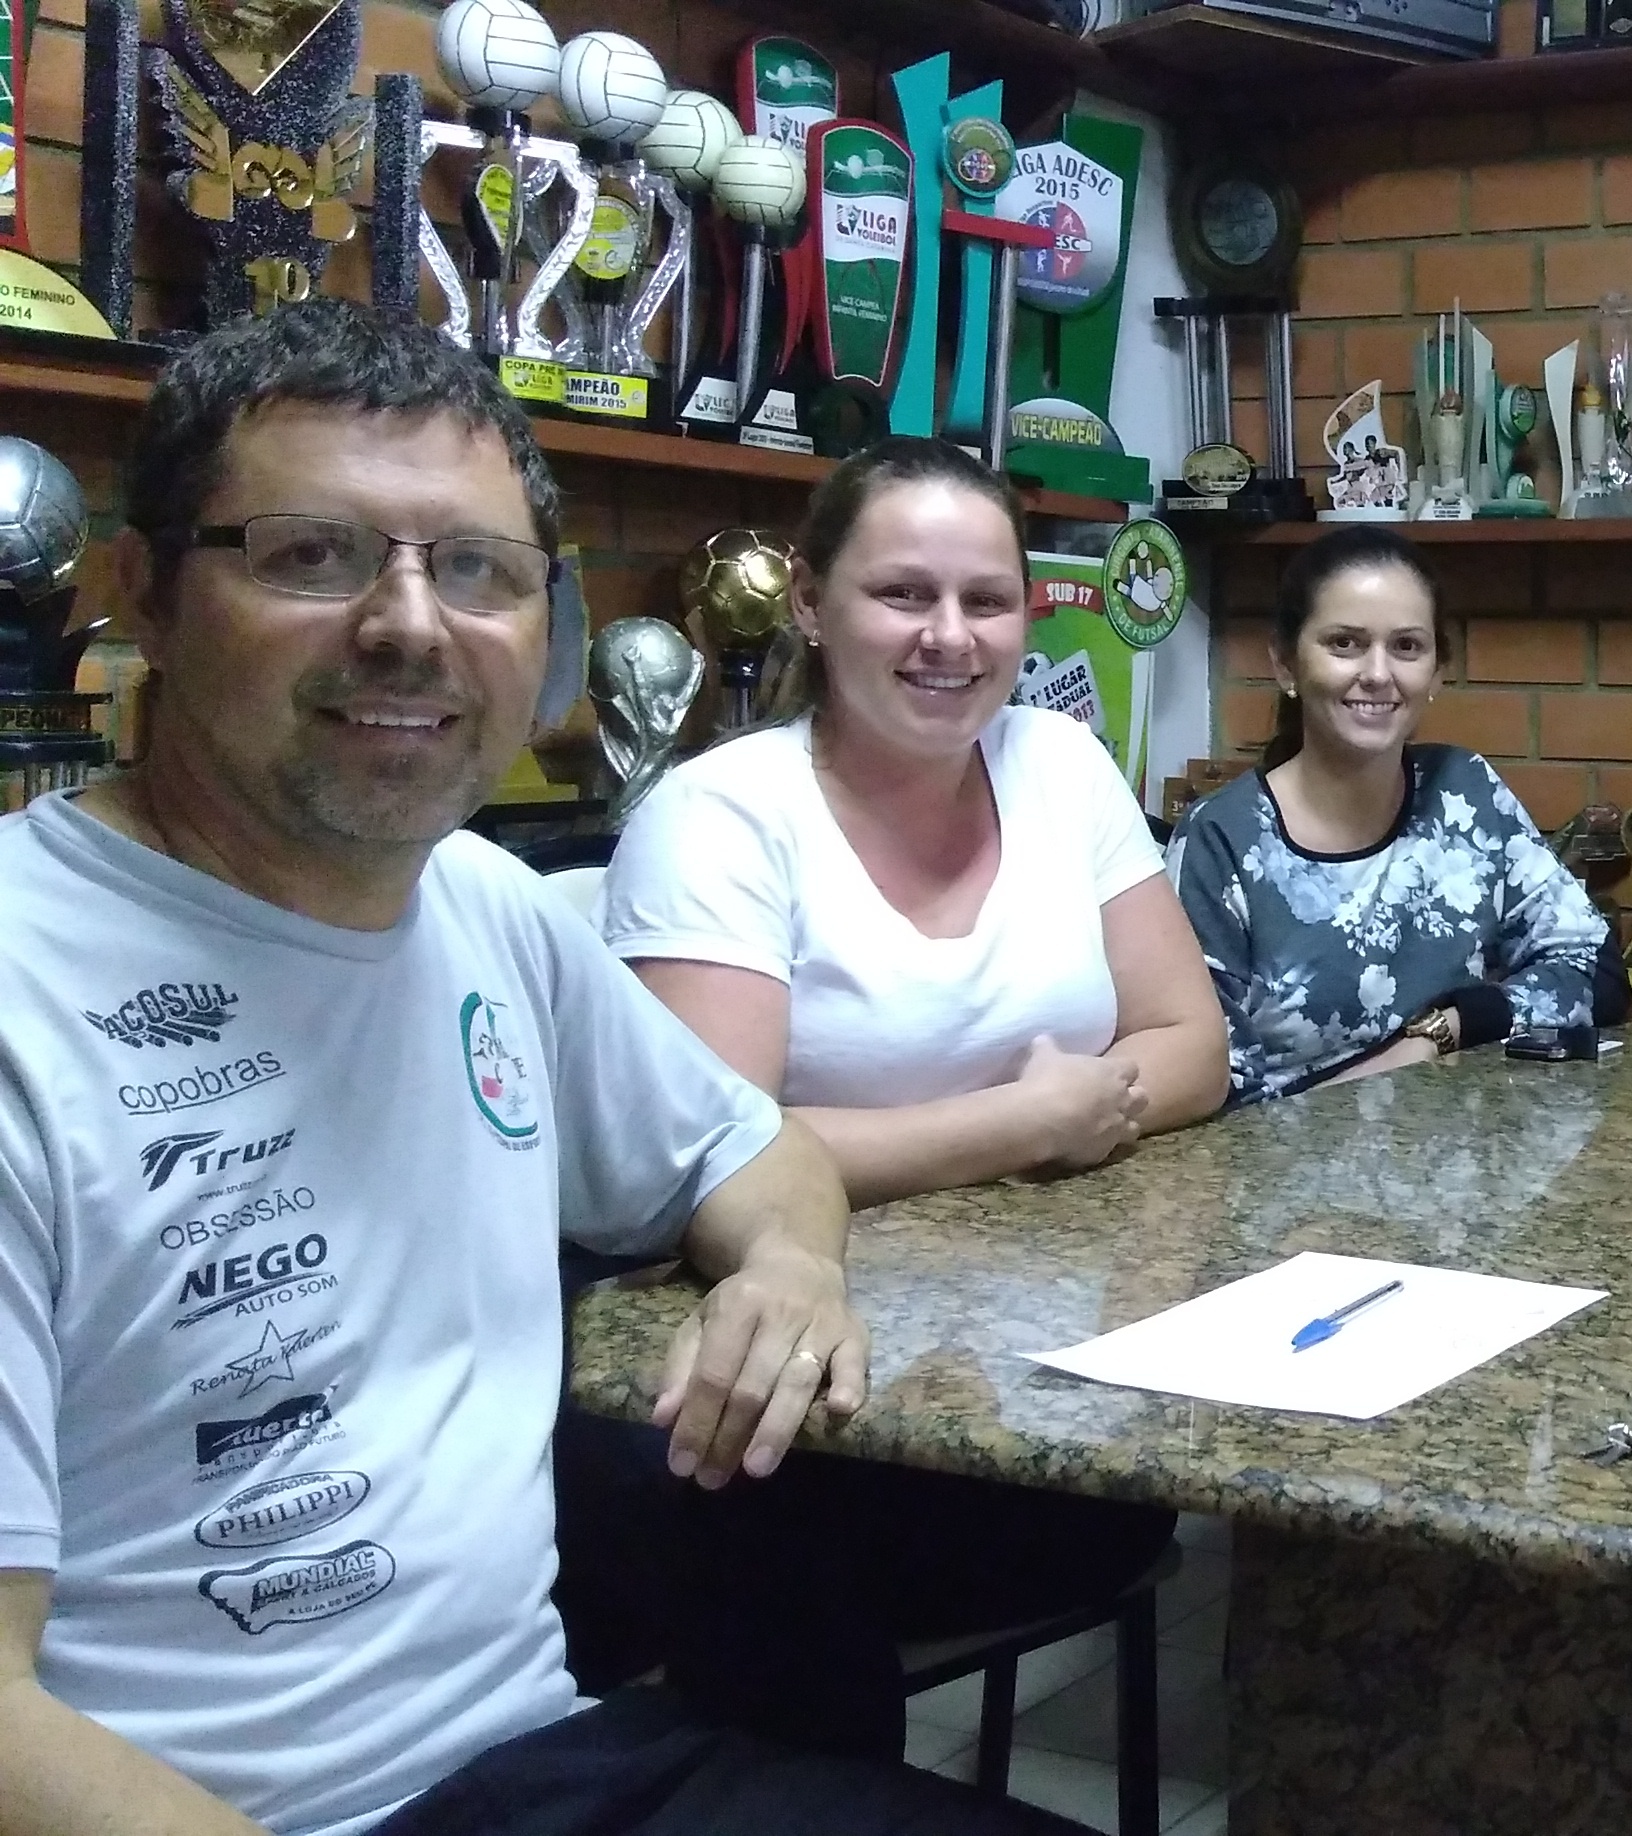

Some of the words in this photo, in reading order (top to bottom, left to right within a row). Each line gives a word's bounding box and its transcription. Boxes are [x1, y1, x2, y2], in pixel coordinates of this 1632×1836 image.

[1012, 152, 1047, 178] IGA
[1053, 154, 1113, 196] ADESC
[1035, 176, 1080, 200] 2015
[857, 228, 896, 246] VOLEIBOL
[863, 210, 897, 234] LIGA
[0, 303, 32, 320] 2014
[14, 286, 76, 306] FEMININO
[505, 360, 536, 372] COPA
[601, 398, 627, 410] 2015
[1011, 415, 1102, 446] VICE-CAMPEÃO
[1046, 582, 1076, 602] SUB
[1078, 586, 1094, 606] 17
[1132, 623, 1170, 641] FUTSAL
[1043, 664, 1088, 701] LUGAR
[118, 1050, 282, 1113] copobras
[190, 1128, 296, 1176] Truzz
[160, 1187, 315, 1250] OBSESSÃO
[178, 1233, 328, 1305] NEGO
[235, 1289, 293, 1317] AUTO
[297, 1274, 339, 1298] SOM
[190, 1355, 277, 1395] Renata
[215, 1480, 355, 1539] PHILIPPI
[257, 1550, 376, 1598] MUNDIAL
[299, 1602, 326, 1614] LOJA
